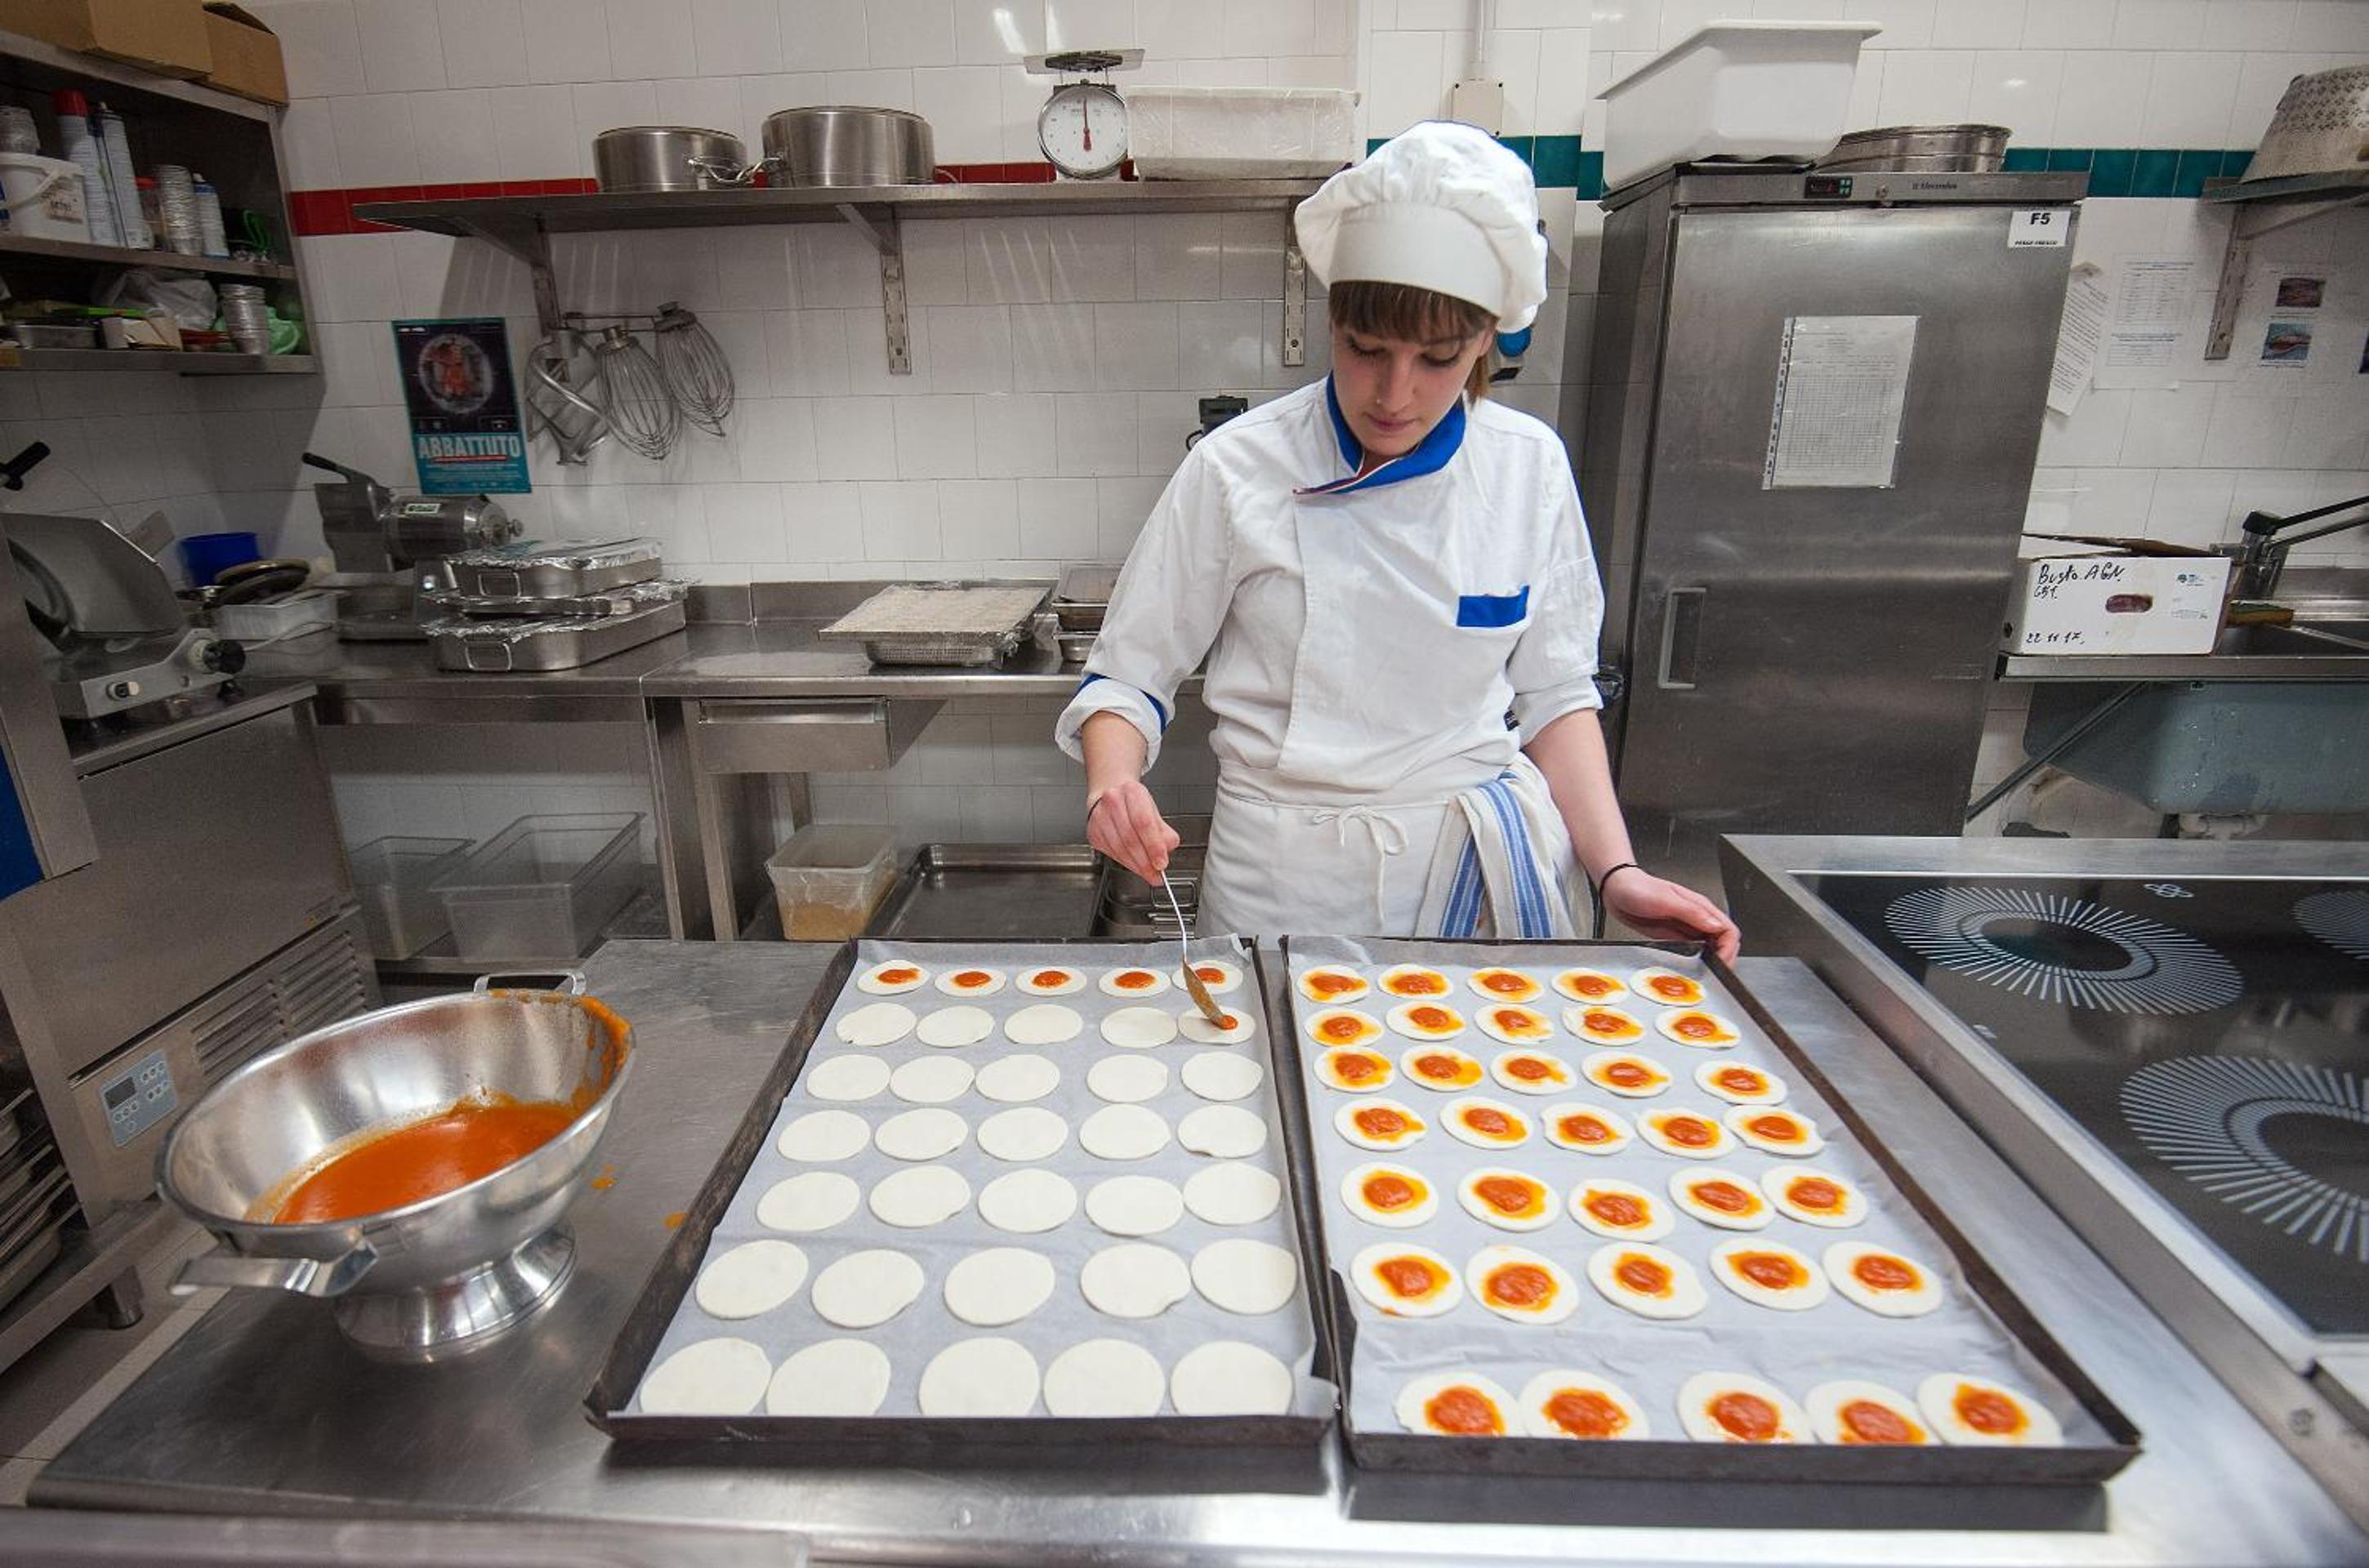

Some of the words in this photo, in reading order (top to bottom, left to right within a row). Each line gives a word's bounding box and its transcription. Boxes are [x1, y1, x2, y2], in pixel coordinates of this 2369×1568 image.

[2031, 212, 2052, 225] F5
[417, 435, 521, 459] ABBATTUTO
[2026, 632, 2041, 644] 22
